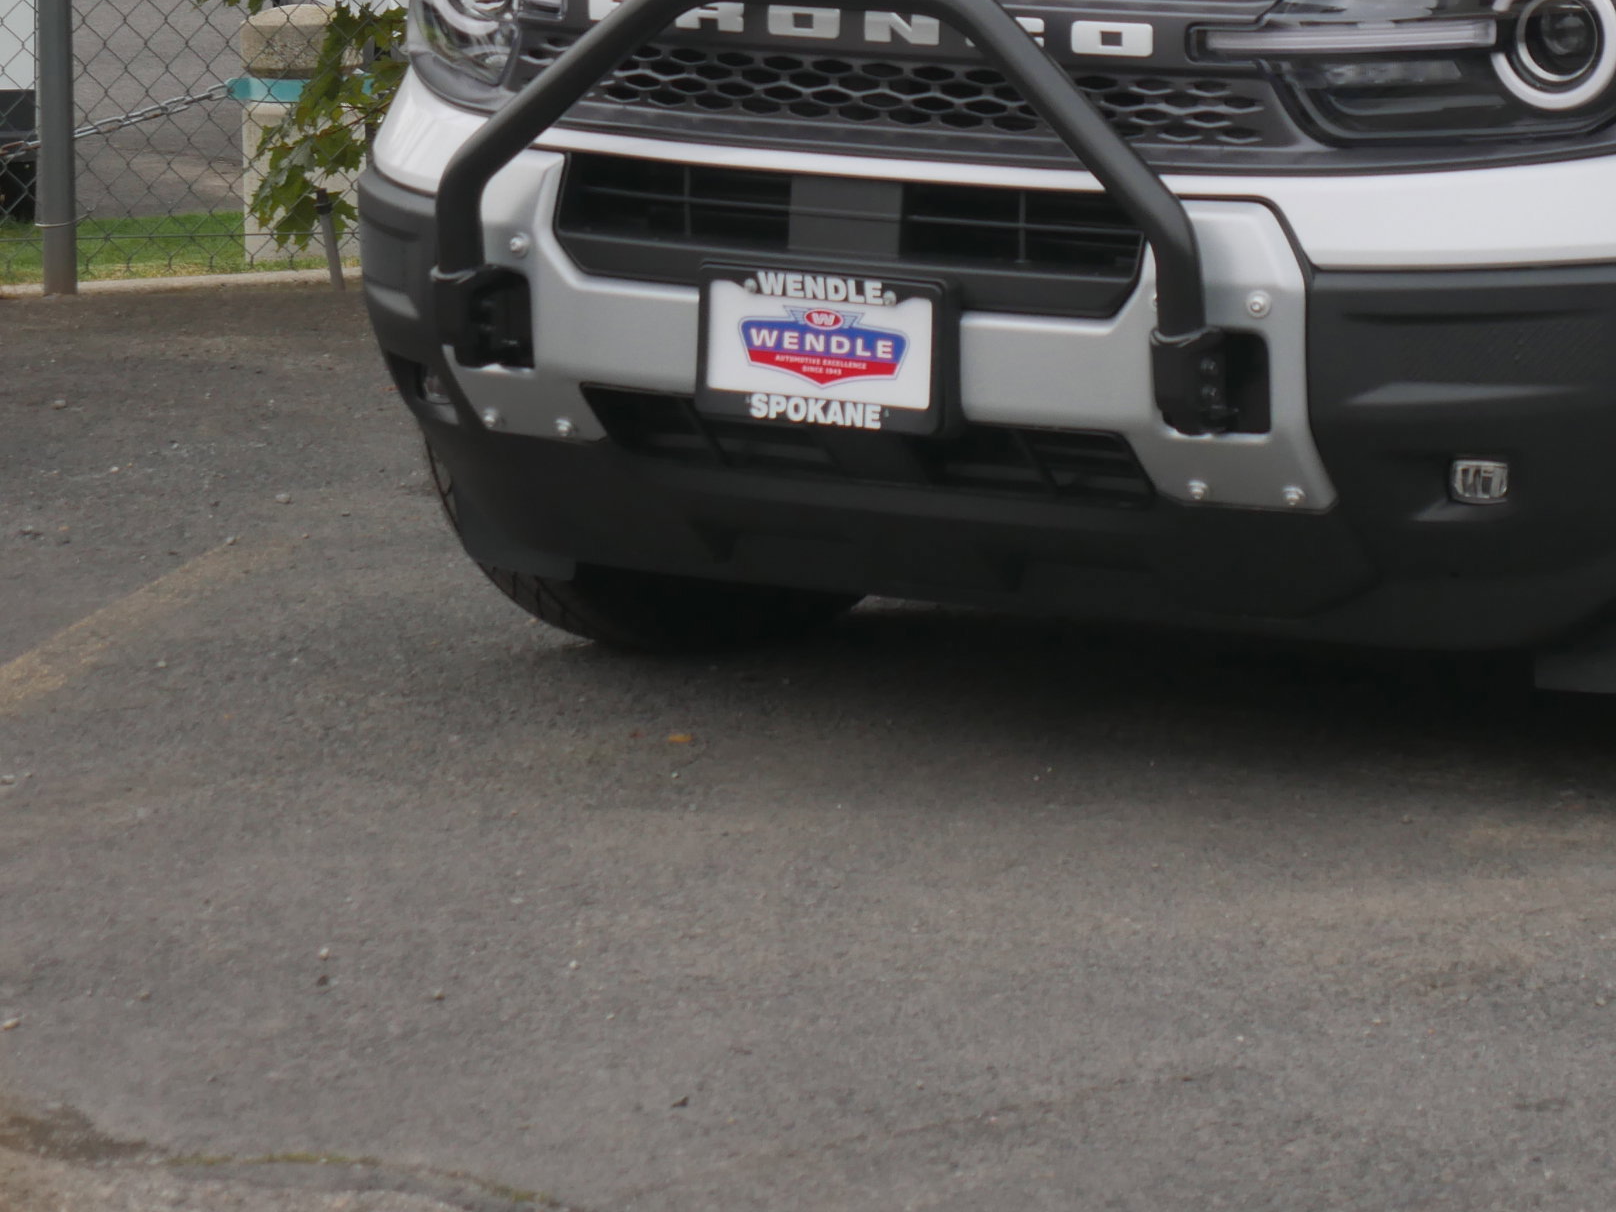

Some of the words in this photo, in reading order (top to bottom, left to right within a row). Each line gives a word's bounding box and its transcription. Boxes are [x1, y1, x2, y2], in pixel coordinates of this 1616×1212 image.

[757, 271, 883, 305] WENDLE
[750, 328, 894, 359] WENDLE
[750, 393, 882, 429] SPOKANE
